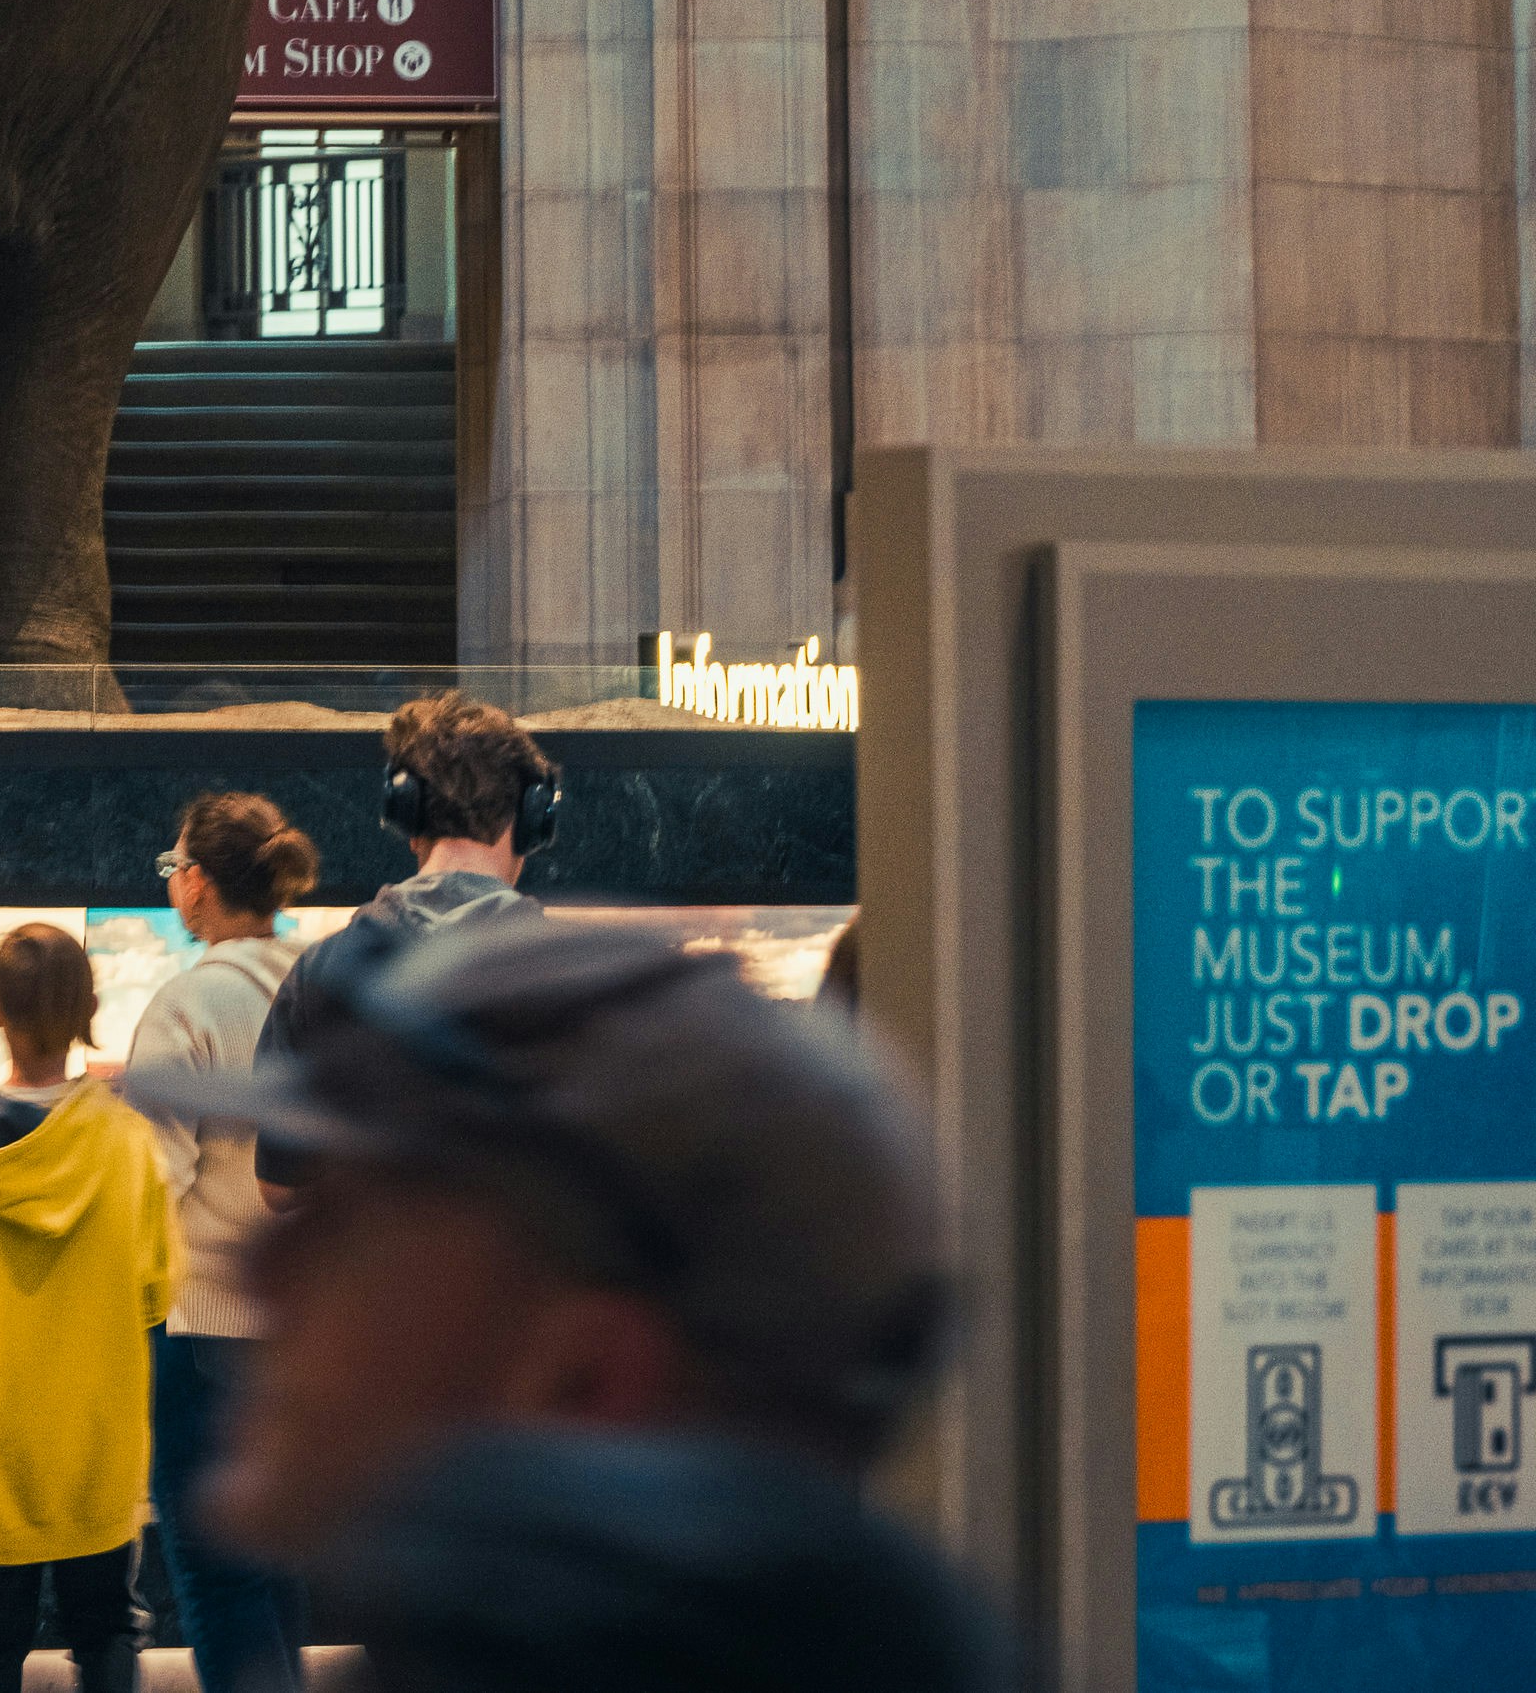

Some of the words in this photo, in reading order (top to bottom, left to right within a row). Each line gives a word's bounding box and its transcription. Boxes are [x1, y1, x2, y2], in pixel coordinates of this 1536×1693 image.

[658, 630, 860, 732] Information
[1189, 787, 1277, 849] TO
[1189, 856, 1305, 915] THE
[1193, 924, 1471, 993] MUSEUM,
[1190, 993, 1330, 1053] JUST
[1348, 991, 1522, 1052] DROP
[1191, 1060, 1279, 1124] OR
[1294, 1060, 1411, 1119] TAP
